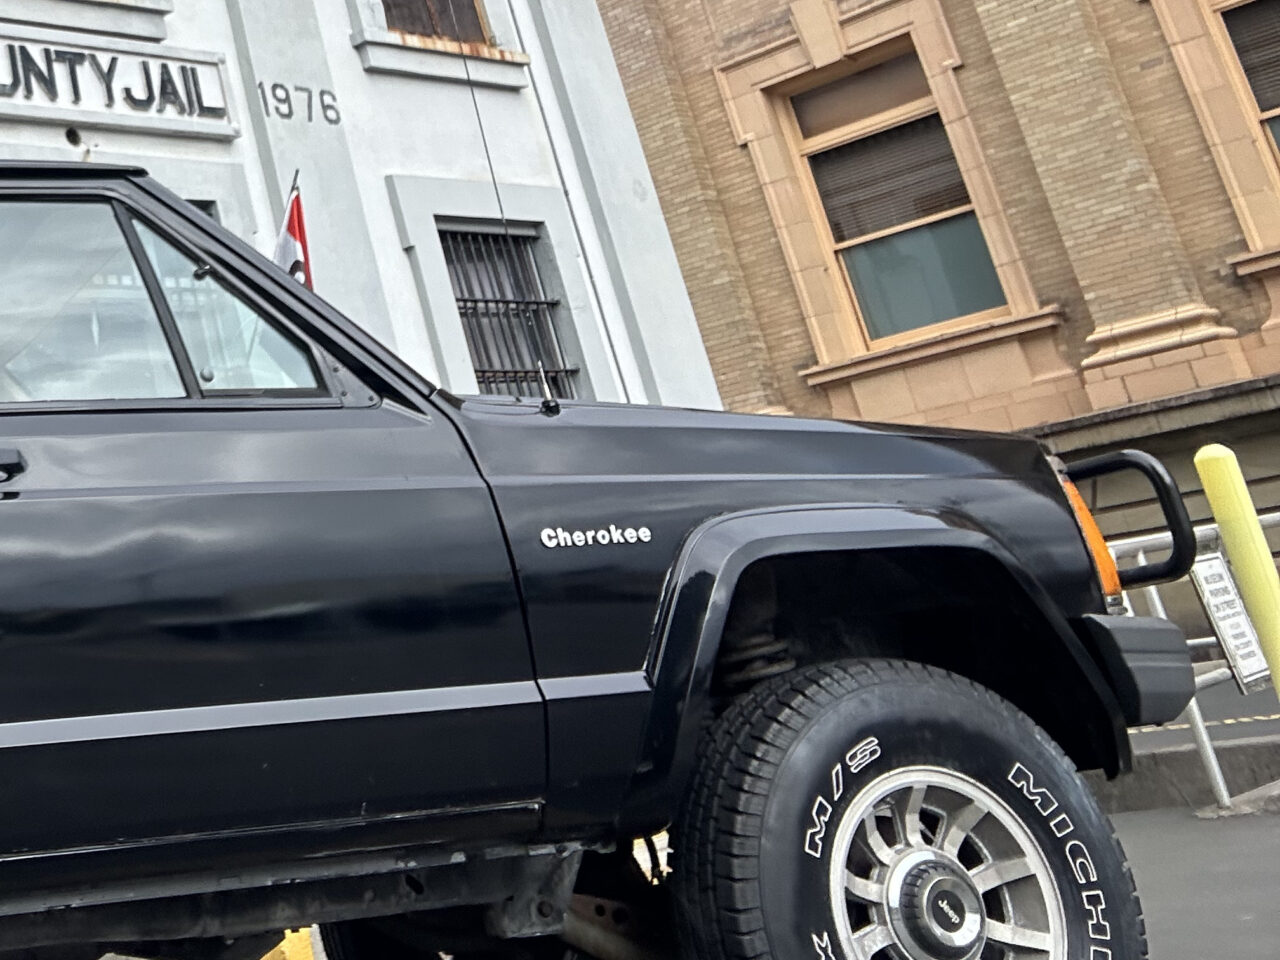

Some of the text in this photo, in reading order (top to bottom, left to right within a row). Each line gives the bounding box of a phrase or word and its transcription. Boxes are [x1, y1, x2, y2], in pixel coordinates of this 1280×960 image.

[124, 60, 227, 117] JAIL
[257, 80, 342, 127] 1976
[540, 524, 652, 549] Cherokee
[937, 899, 960, 924] Jeep
